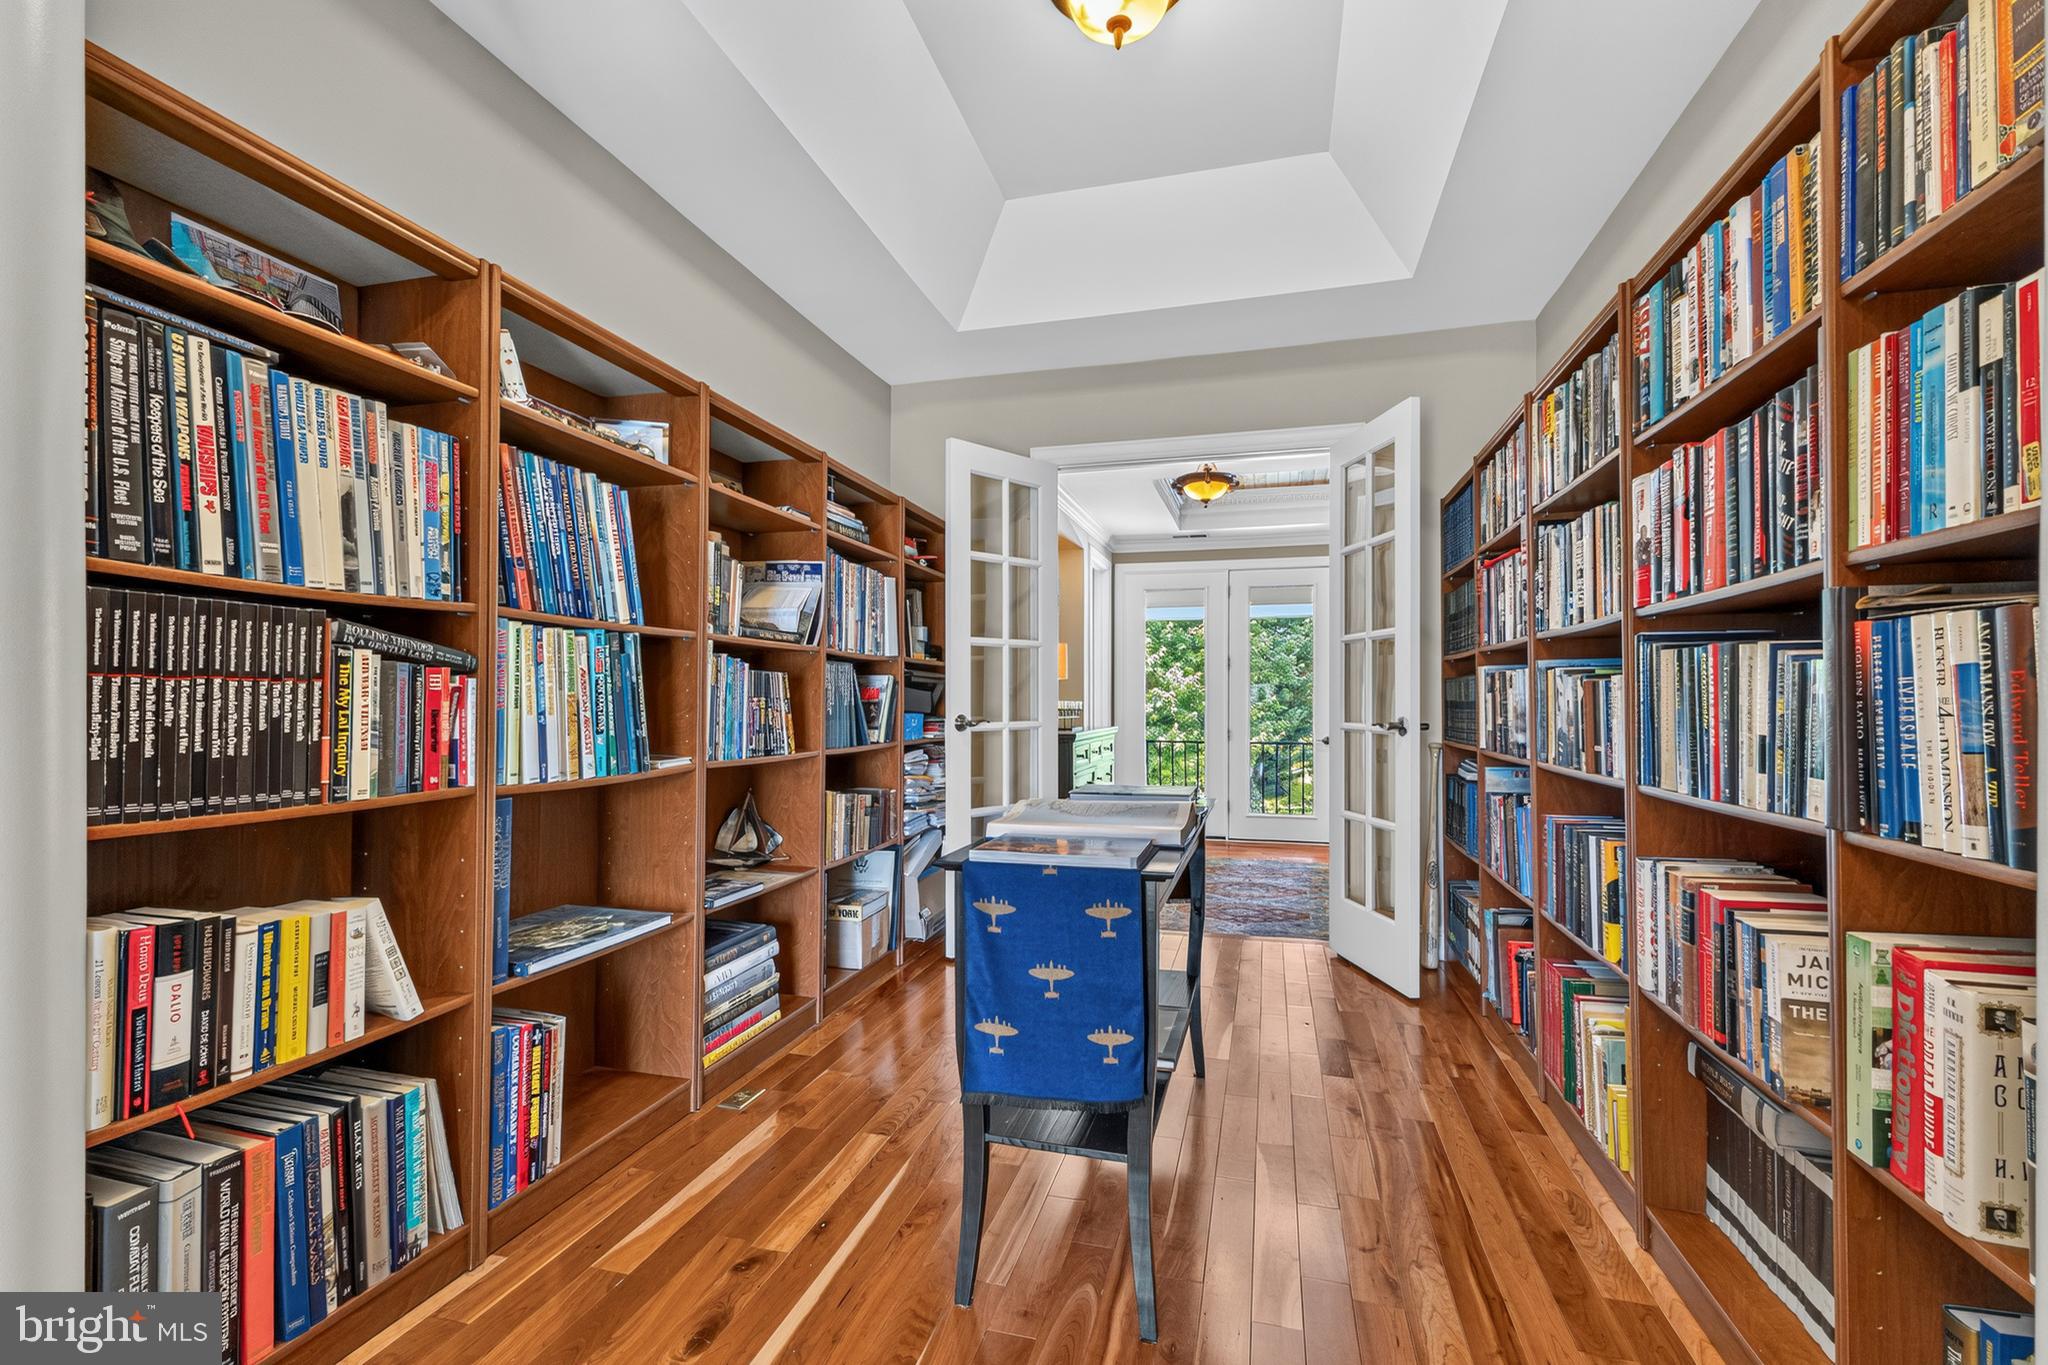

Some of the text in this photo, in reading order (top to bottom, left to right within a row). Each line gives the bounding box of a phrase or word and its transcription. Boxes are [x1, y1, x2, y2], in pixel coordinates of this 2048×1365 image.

[107, 338, 127, 366] Ships
[110, 366, 128, 387] and
[172, 353, 188, 393] NAVAL
[110, 386, 128, 425] Aircraft
[147, 393, 164, 442] Keepers
[111, 426, 129, 439] of
[111, 440, 129, 456] the
[176, 396, 192, 461] WEAPONS
[1984, 407, 1996, 451] POWER
[112, 457, 130, 477] U.S.
[150, 443, 167, 457] of
[151, 457, 167, 478] the
[195, 424, 219, 497] WARSHIPS
[113, 480, 131, 506] Fleet
[152, 479, 168, 503] Sea
[1986, 468, 1996, 499] ONE
[342, 634, 356, 643] IN
[367, 640, 404, 656] GENTLE
[404, 648, 434, 662] LAND
[345, 624, 435, 655] ROLLING THUNDER
[1980, 621, 1991, 641] AN
[360, 654, 371, 675] AIR
[1854, 645, 1865, 698] GOLDEN
[1934, 626, 1947, 688] RUCKER
[1980, 642, 1992, 669] OLD
[334, 664, 351, 777] The My Lai Inquiry
[1856, 700, 1866, 741] RATIO
[1871, 634, 1887, 770] PERFECT SYMMETRY
[360, 703, 370, 752] VIETNAM
[1896, 675, 1917, 771] HYPERSPACE
[1983, 717, 1997, 748] TOY
[2010, 669, 2030, 810] Edward Teller
[179, 737, 189, 754] War
[1927, 763, 1936, 806] HIDDEN
[1940, 738, 1955, 835] DIMENSION
[837, 909, 860, 919] YORK
[137, 935, 152, 1004] Homo Deus
[201, 926, 214, 1001] NAZI BILLIONAIRES
[261, 930, 275, 977] Wernher
[169, 983, 183, 1024] DALIO
[260, 999, 272, 1031] Braun
[1788, 1004, 1829, 1021] THE
[132, 1013, 147, 1093] Yuval Noah Harari
[199, 1009, 211, 1068] DAVID DE JONG
[1893, 988, 1917, 1176] Dictionary
[1923, 1039, 1936, 1150] GREAT DIVIDE
[1945, 1040, 1957, 1166] AMERICAN COLOSSUS
[352, 1120, 363, 1190] BLACK JETS
[396, 1104, 407, 1212] WAR IN THE PACIFIC
[219, 1177, 231, 1220] WORLD
[230, 1202, 240, 1220] THE
[288, 1190, 296, 1222] Collector's
[129, 1224, 142, 1274] COMBAT
[219, 1221, 230, 1255] NAVAL
[230, 1221, 240, 1244] NAVAL
[140, 1242, 150, 1286] THE NAVAL
[219, 1257, 230, 1299] WEAPON
[289, 1242, 298, 1286] Compendium
[229, 1305, 239, 1319] TO
[230, 1282, 239, 1304] GUIDE
